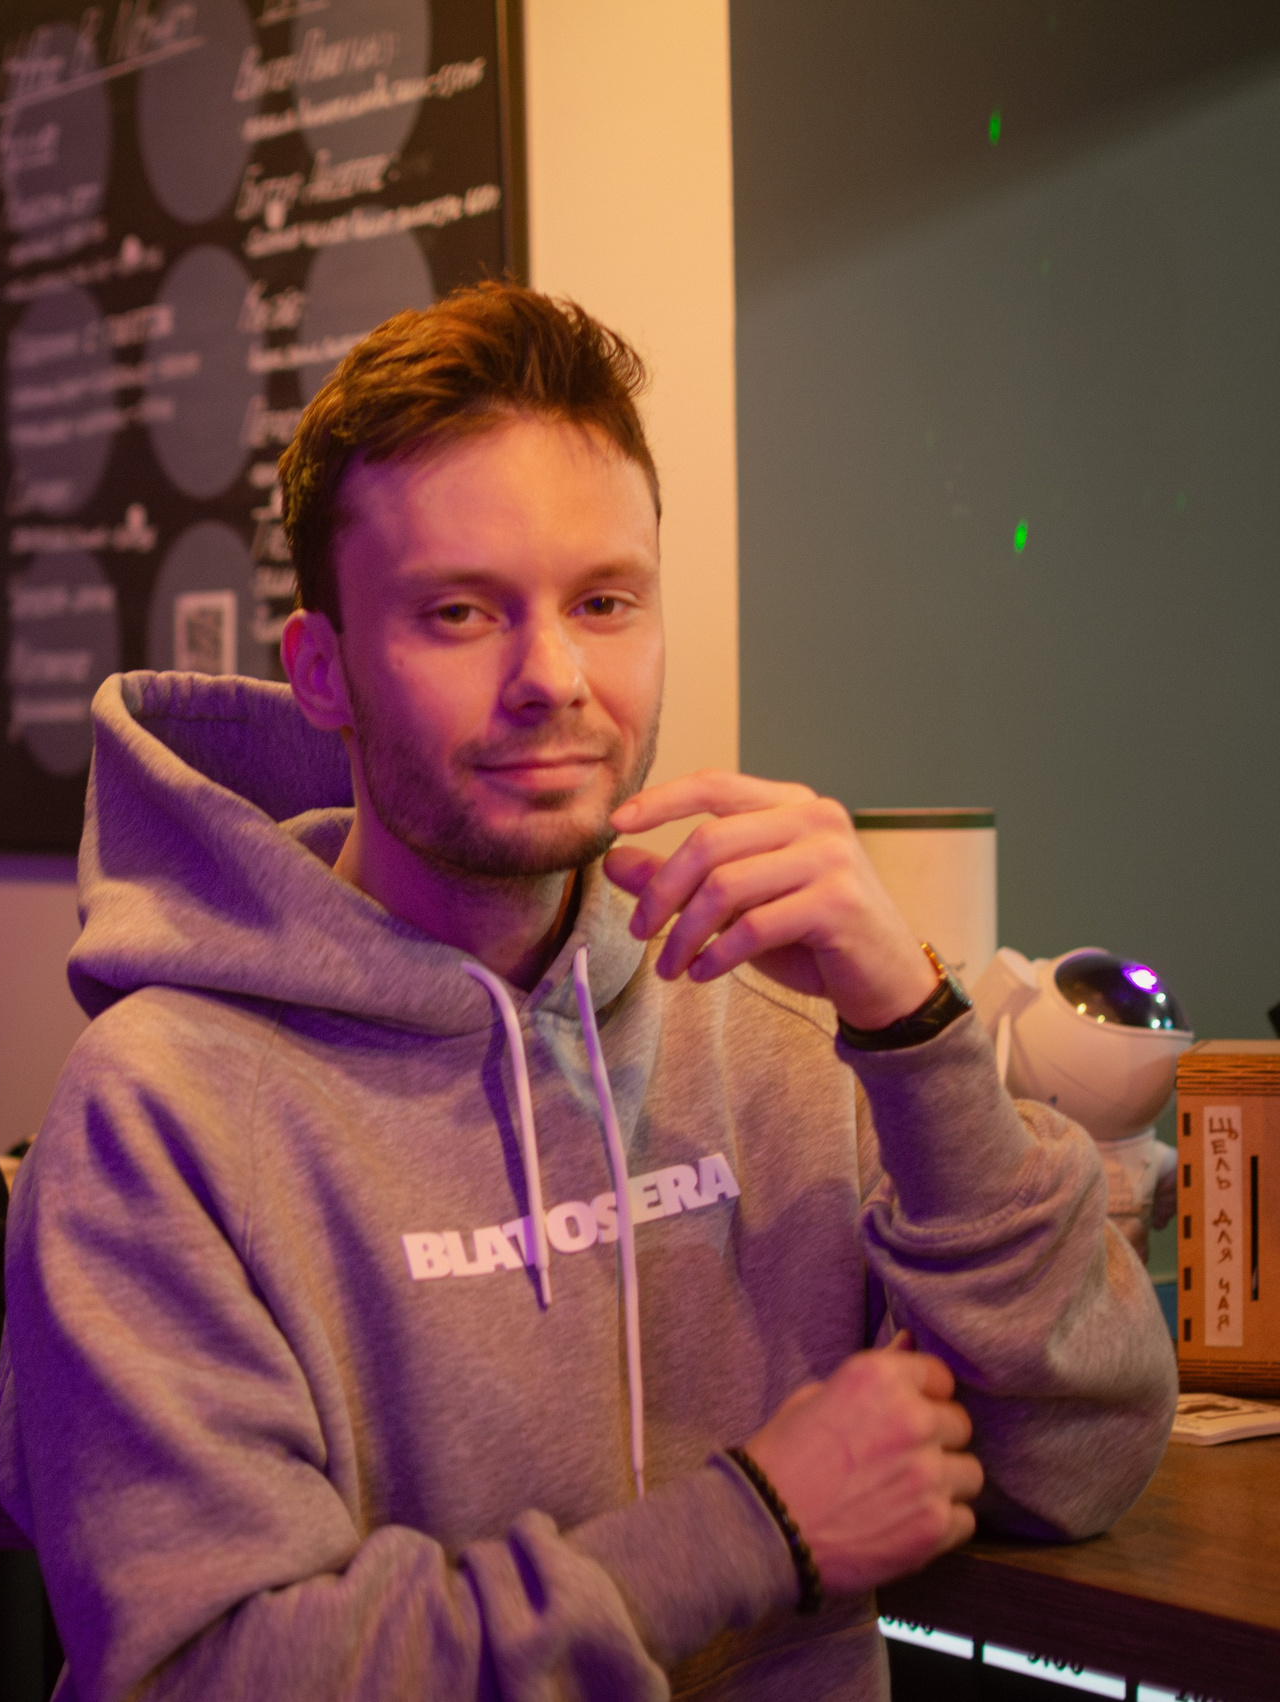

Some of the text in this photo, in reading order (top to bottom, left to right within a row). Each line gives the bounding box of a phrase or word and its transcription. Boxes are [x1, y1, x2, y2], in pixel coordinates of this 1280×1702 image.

[1209, 1117, 1239, 1332] ЩЕЛЬ ДЛЯ ЧАЯ
